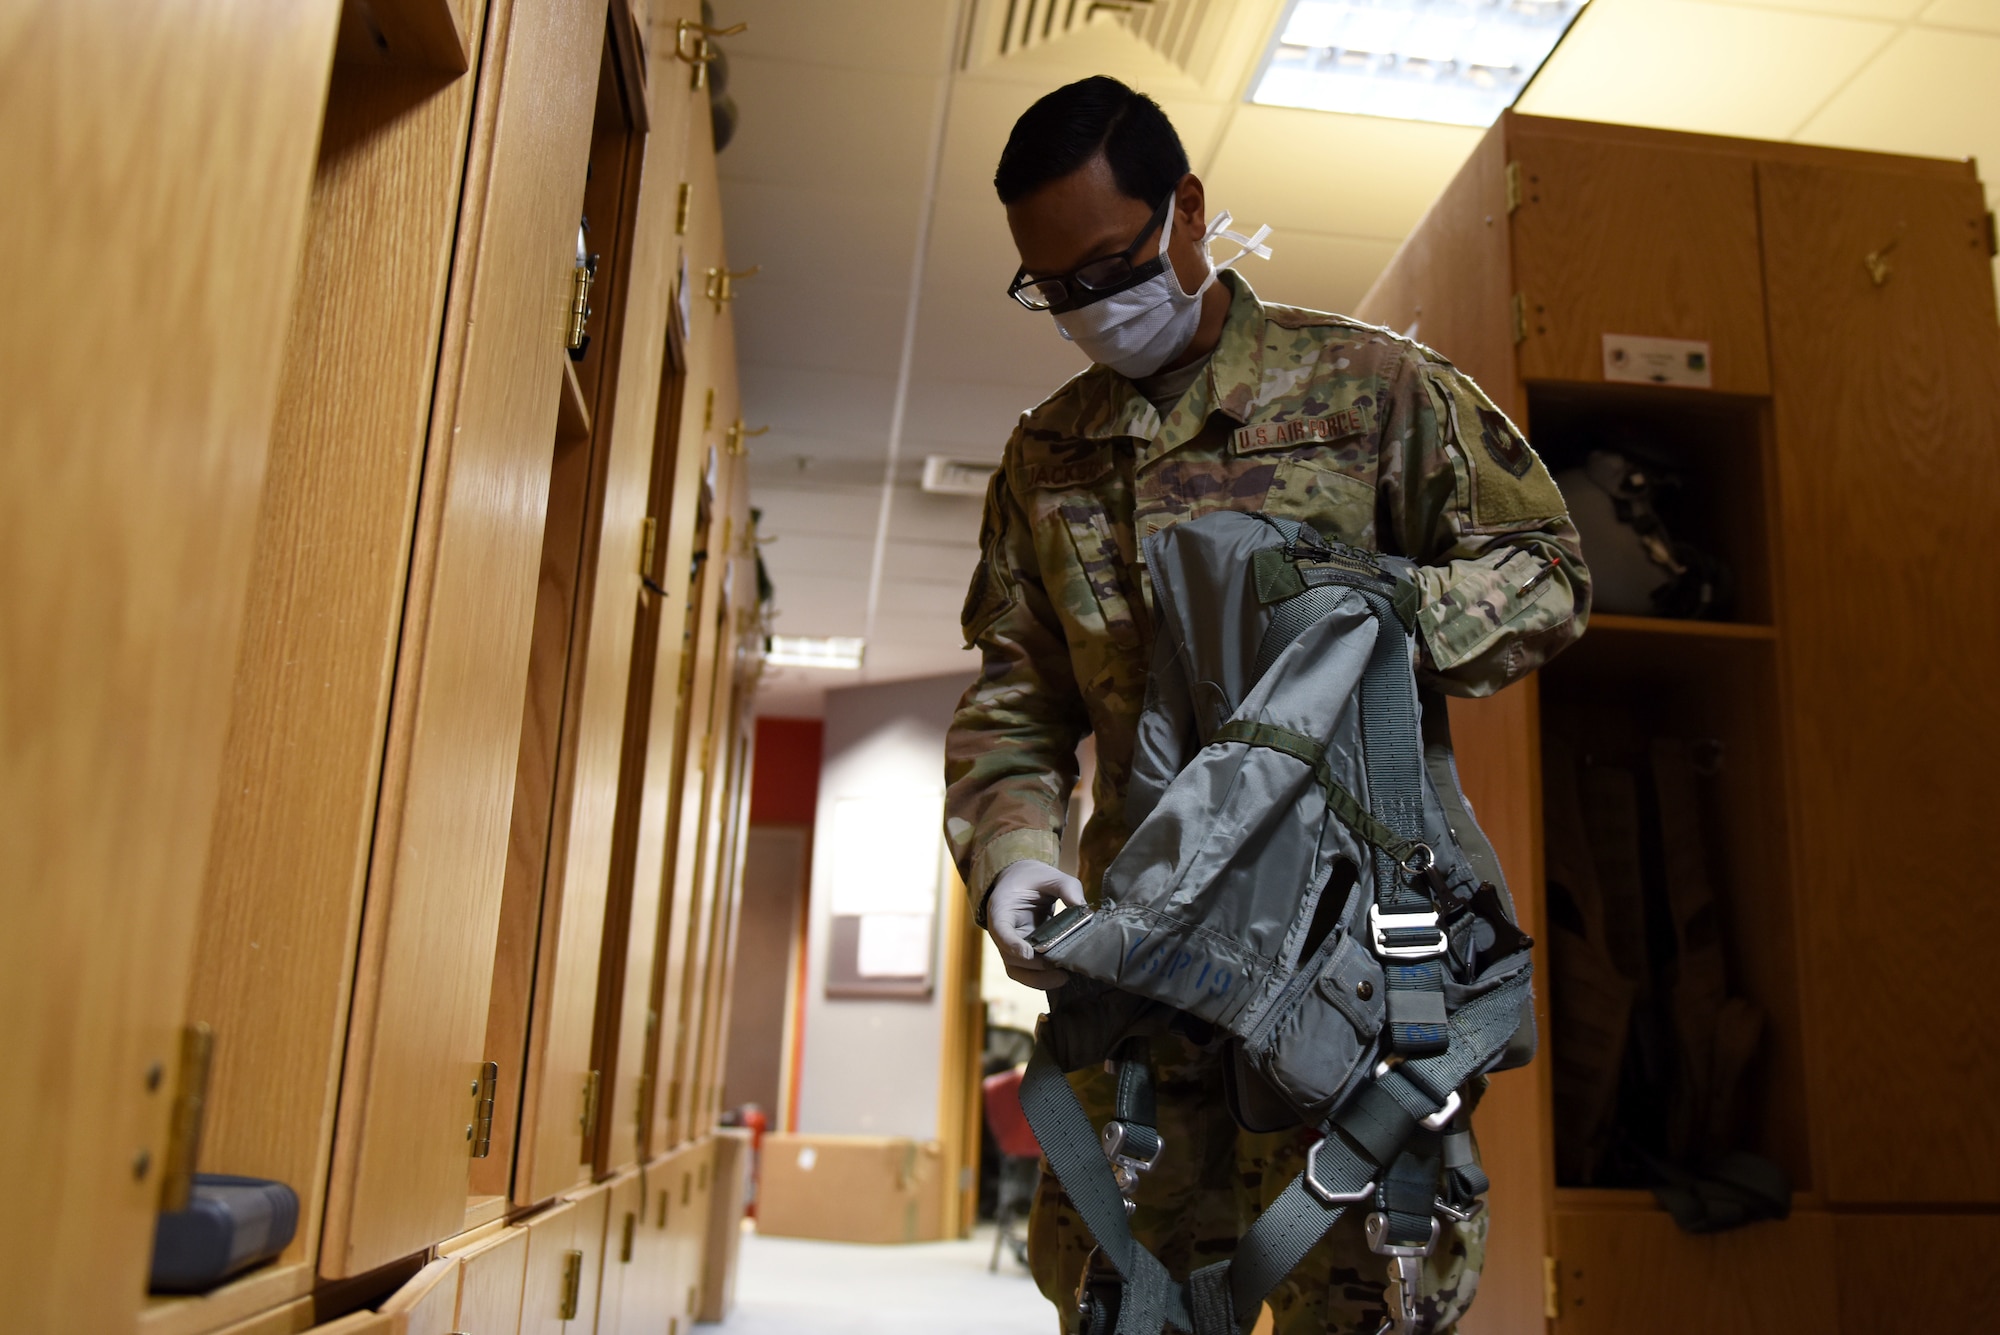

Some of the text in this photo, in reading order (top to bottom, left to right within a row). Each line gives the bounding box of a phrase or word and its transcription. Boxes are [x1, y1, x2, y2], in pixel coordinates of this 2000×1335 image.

[1239, 409, 1361, 448] U.S. AIR FORCE
